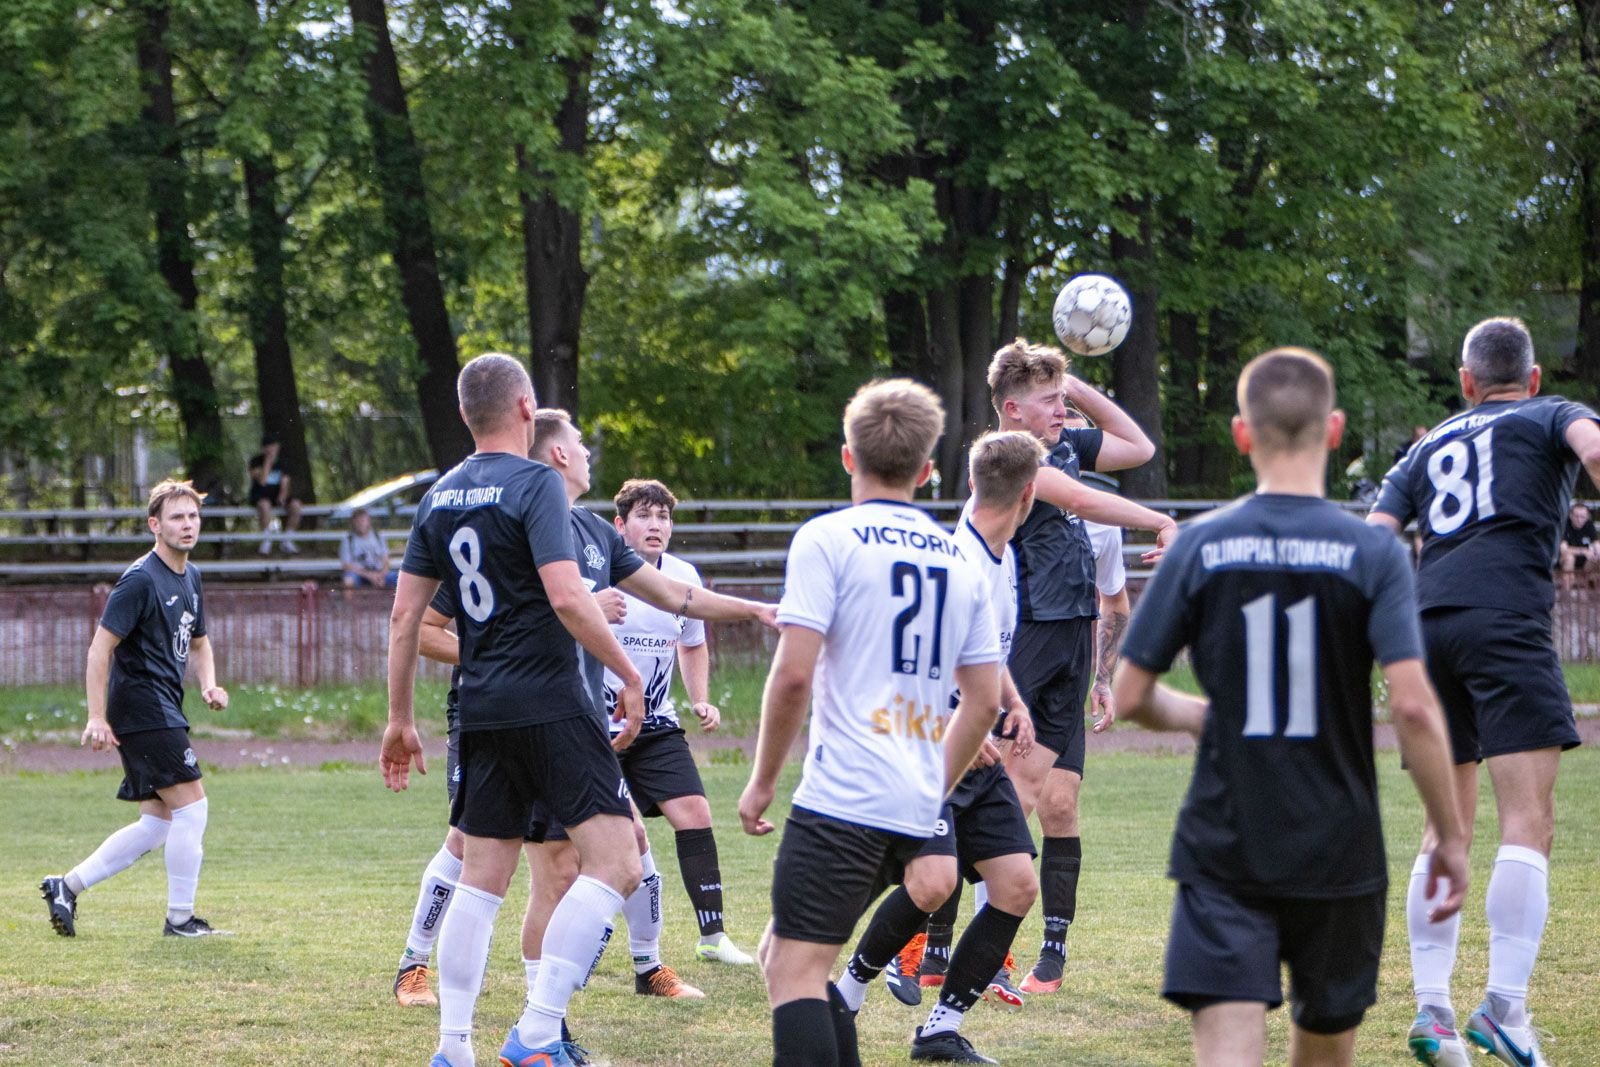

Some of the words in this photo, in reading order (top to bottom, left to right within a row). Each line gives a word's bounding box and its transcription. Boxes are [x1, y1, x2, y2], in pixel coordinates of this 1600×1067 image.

[1427, 427, 1497, 537] 81
[449, 526, 495, 623] 8
[1201, 536, 1275, 570] OLIMPIA
[1275, 537, 1357, 571] KOWARY
[891, 560, 949, 680] 21
[1241, 592, 1318, 738] 11
